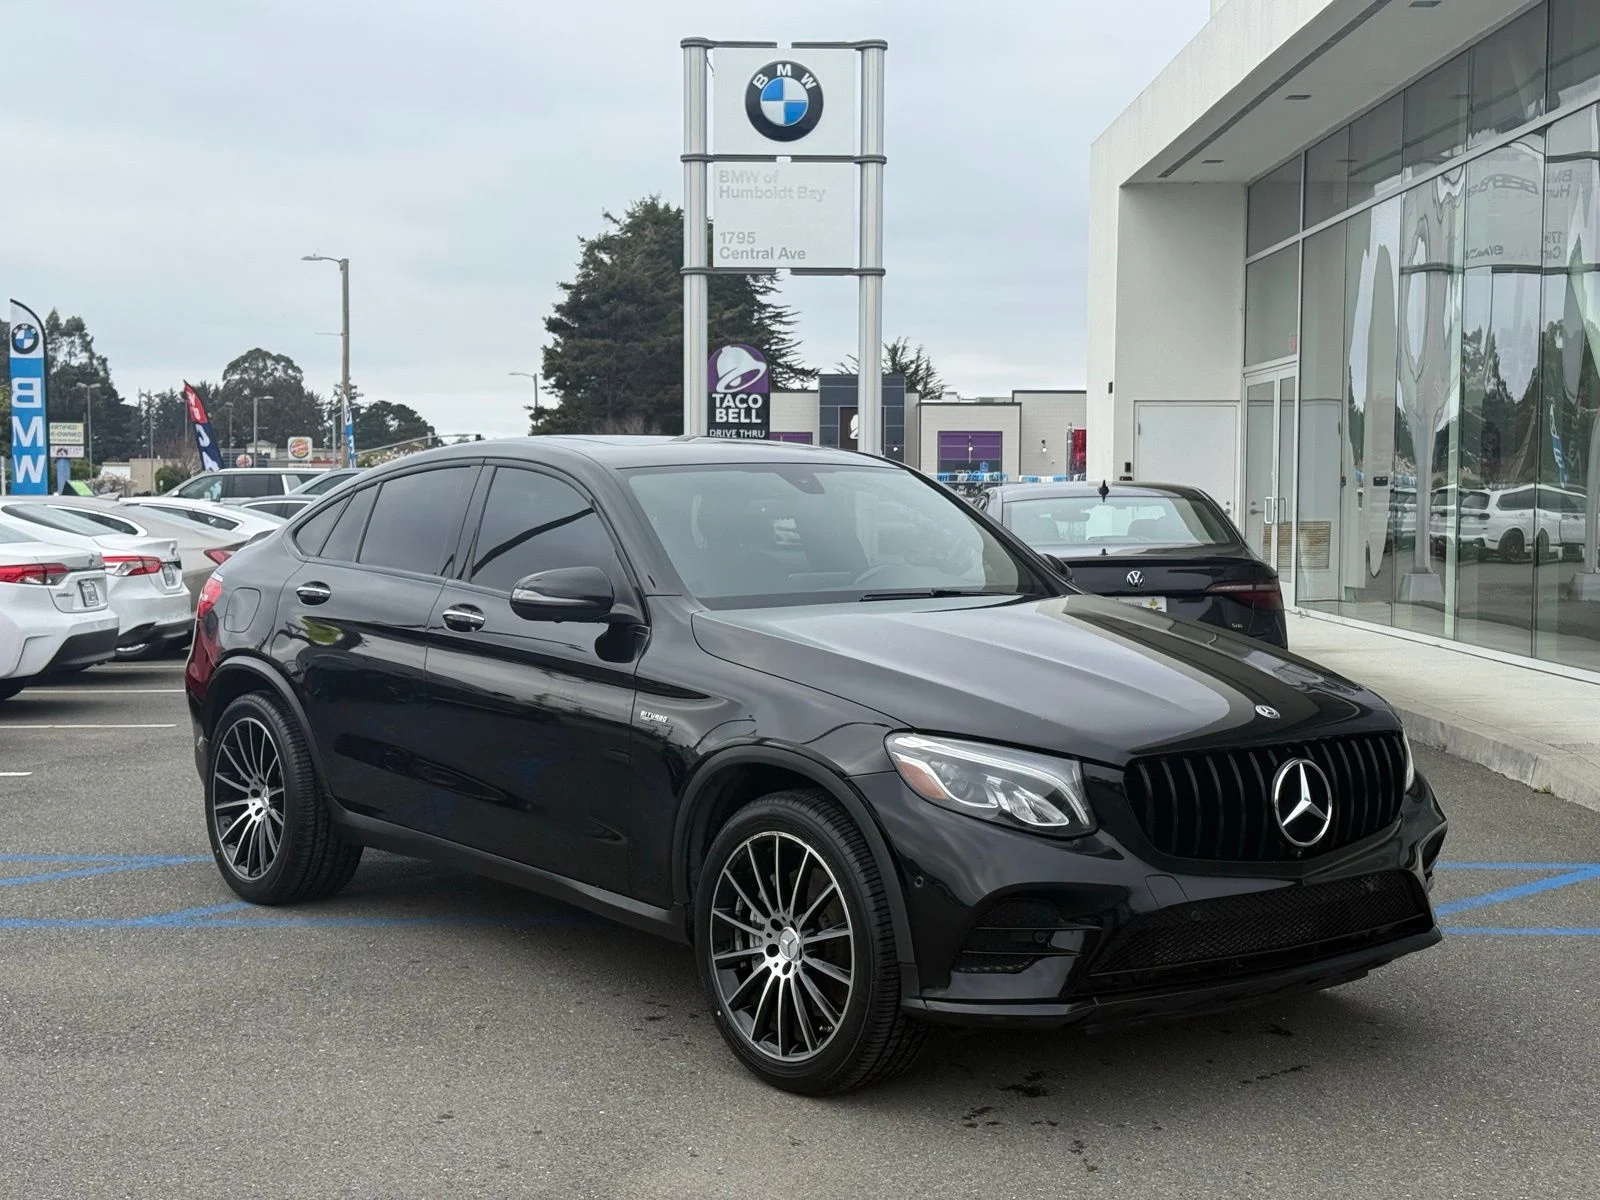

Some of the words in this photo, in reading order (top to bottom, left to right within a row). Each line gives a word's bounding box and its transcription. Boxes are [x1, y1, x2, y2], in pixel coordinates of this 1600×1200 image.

[752, 63, 817, 90] BMW
[719, 170, 760, 184] BMW
[763, 169, 779, 184] of
[719, 185, 793, 199] Humboldt
[797, 186, 826, 202] Bay
[720, 231, 756, 244] 1795
[720, 246, 774, 260] Central
[778, 247, 806, 260] Ave
[712, 393, 762, 408] TACO
[715, 408, 761, 423] BELL
[709, 428, 738, 438] DRIVE
[739, 429, 765, 438] THRU
[640, 710, 669, 723] BITURBO
